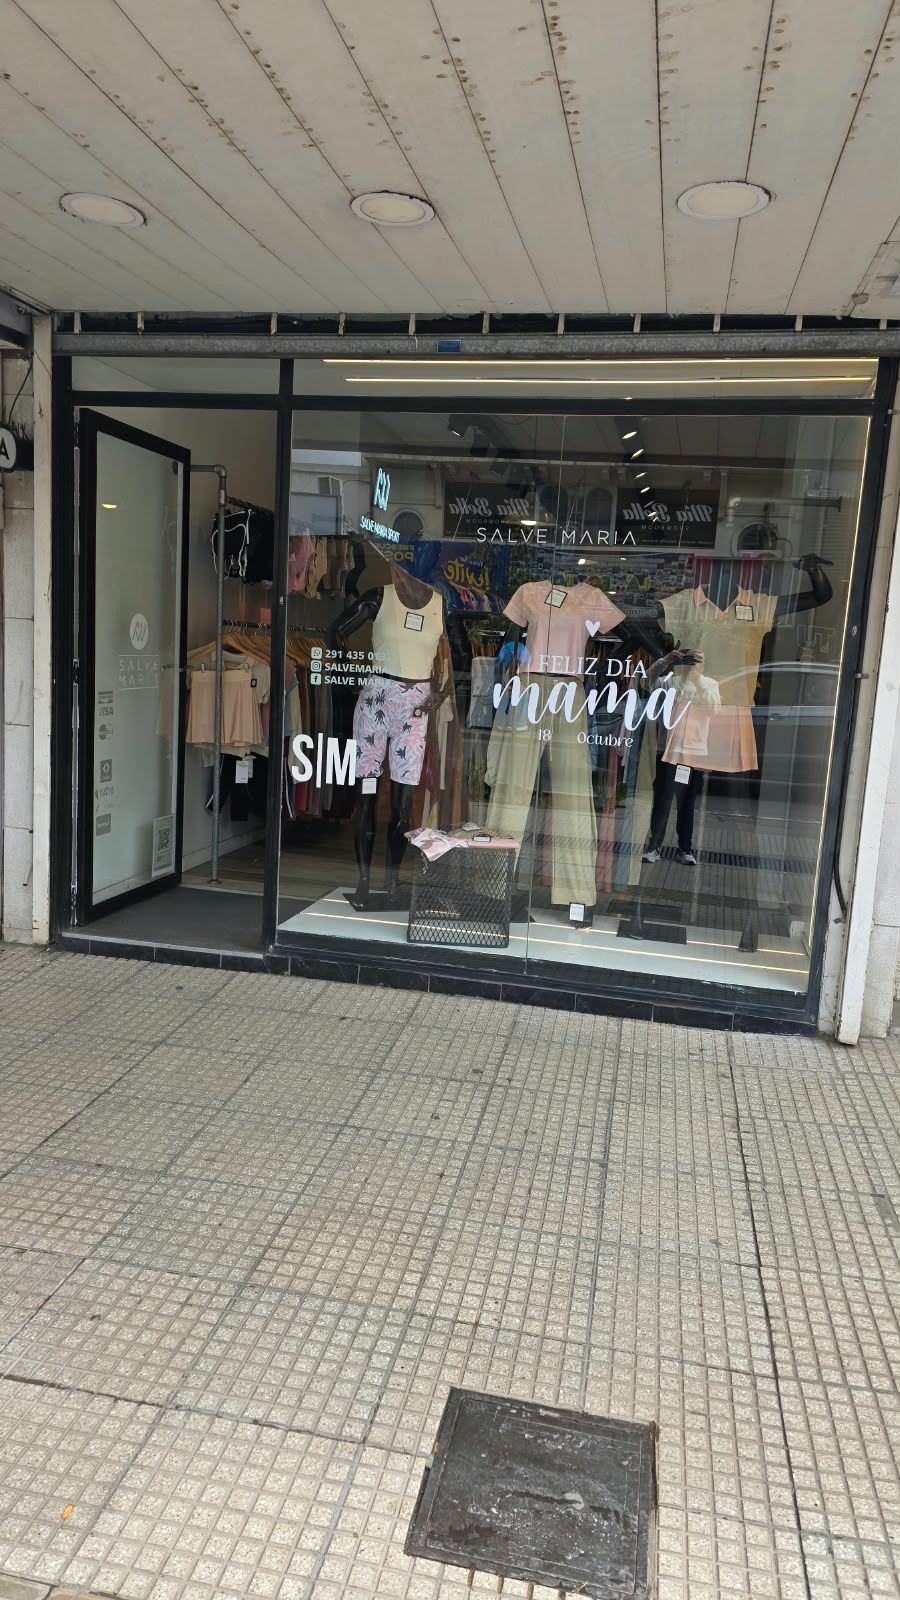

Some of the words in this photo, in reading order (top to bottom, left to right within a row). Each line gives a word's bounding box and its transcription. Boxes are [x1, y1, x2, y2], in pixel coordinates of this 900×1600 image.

[476, 527, 548, 544] SALVE
[561, 530, 637, 546] MARIA
[325, 649, 342, 659] 291
[346, 651, 365, 660] 435
[538, 654, 598, 676] FELIZ
[606, 655, 648, 679] DÍA
[324, 675, 355, 686] SALVE
[493, 671, 692, 731] mamá
[538, 729, 552, 741] 18
[577, 731, 634, 748] Octubre
